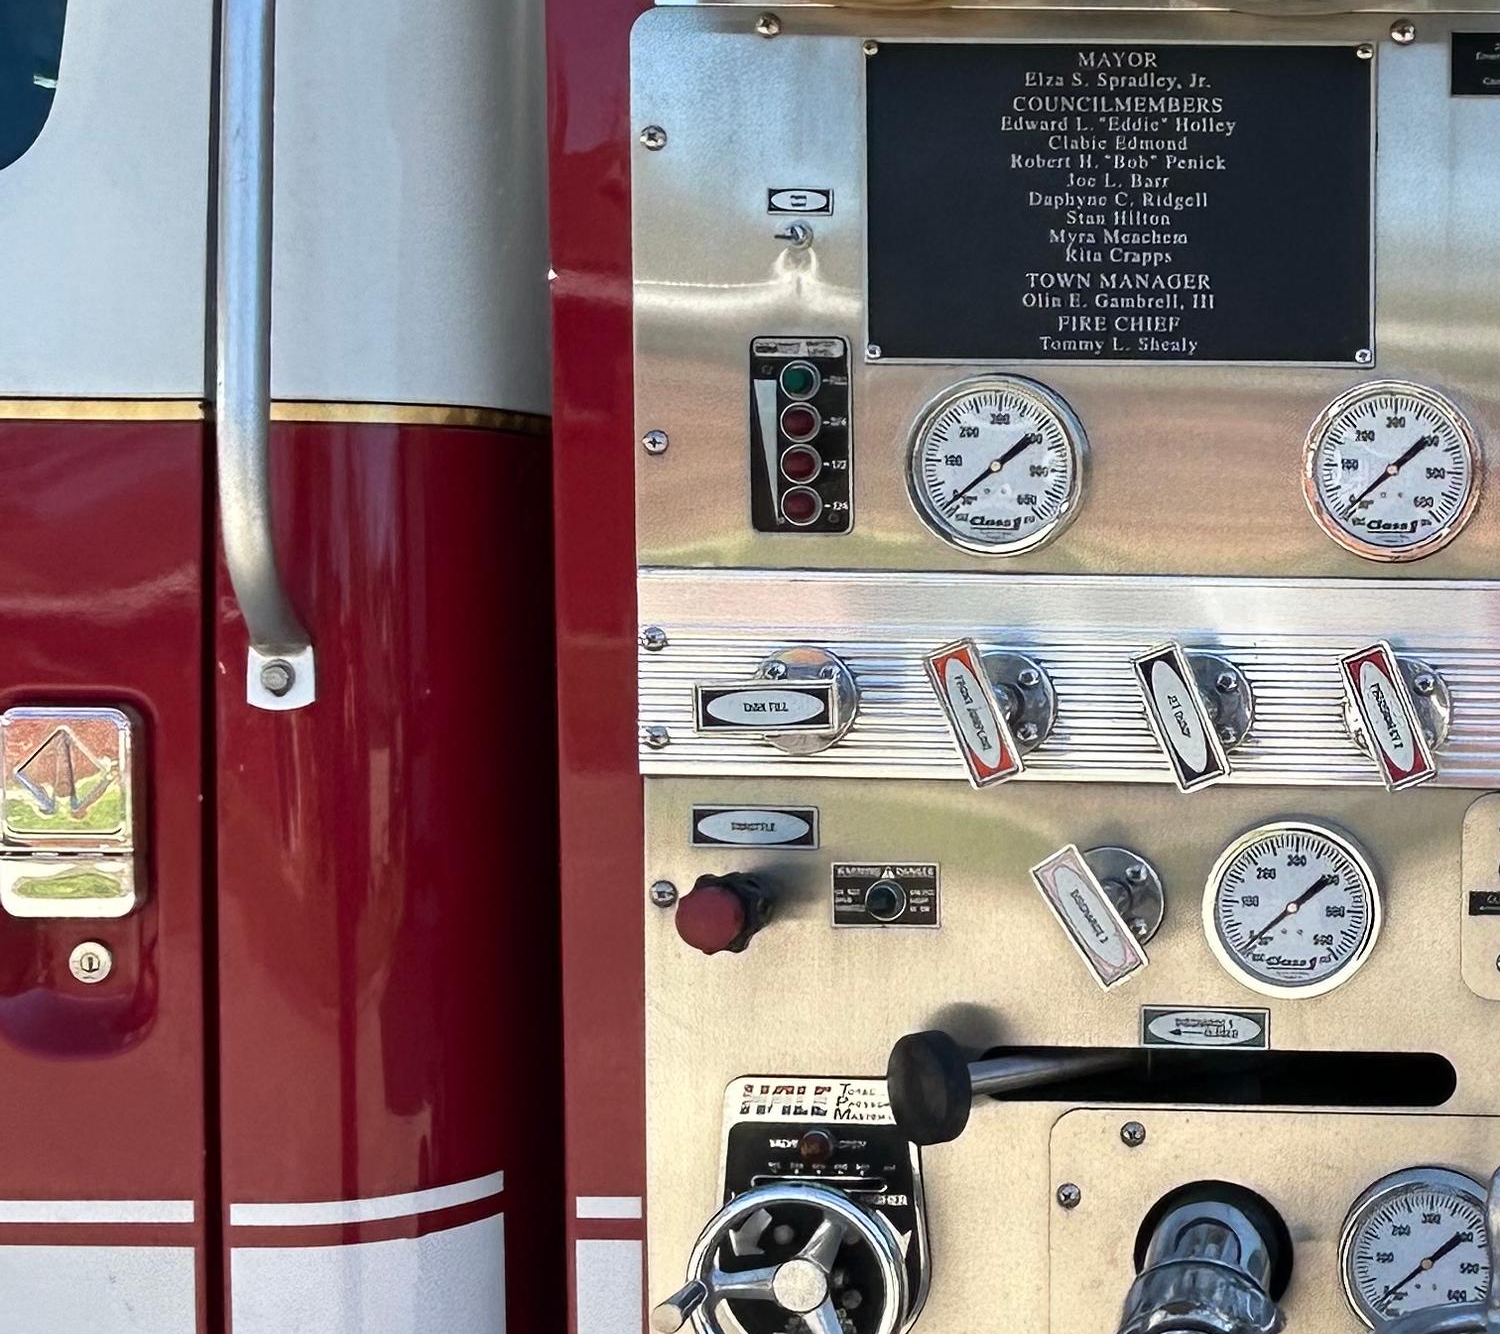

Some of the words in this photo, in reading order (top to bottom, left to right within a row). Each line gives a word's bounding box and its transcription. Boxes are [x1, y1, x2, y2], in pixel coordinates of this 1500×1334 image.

[1078, 52, 1158, 67] MAYOR
[1025, 72, 1064, 87] Elza
[1072, 72, 1089, 87] S.
[1097, 72, 1182, 91] Spradley,
[1189, 73, 1211, 88] Jr.
[1013, 96, 1223, 113] COUNCILMEMBERS
[1001, 116, 1068, 131] Edward
[1076, 117, 1094, 131] L.
[1100, 117, 1168, 131] "Eddie"
[1176, 117, 1236, 136] Holley
[1116, 136, 1188, 150] Edmond
[1010, 154, 1071, 168] Robert
[1080, 154, 1098, 168] H.
[1104, 155, 1157, 169] "Bob"
[1166, 155, 1226, 170] Penick
[1067, 173, 1096, 188] Joe
[1104, 173, 1122, 188] L.
[1131, 174, 1170, 188] Barr
[1029, 191, 1107, 210] Daphyne
[1115, 192, 1134, 207] C.
[1143, 193, 1208, 210] Ridgell
[1067, 211, 1105, 225] Stan
[1114, 211, 1170, 226] Hilton
[1050, 229, 1096, 247] Myra
[1110, 247, 1172, 267] Crapps
[1025, 273, 1091, 289] TOWN
[1100, 274, 1211, 290] MANAGER
[1022, 293, 1061, 308] Olin
[1069, 293, 1087, 308] E.
[1095, 293, 1184, 310] Gambrell,
[1192, 294, 1214, 309] III
[1058, 316, 1107, 332] FIRE
[1115, 317, 1181, 332] CHIEF
[1040, 336, 1104, 354] Tommy
[1112, 337, 1131, 351] L.
[1138, 337, 1198, 355] Shealy
